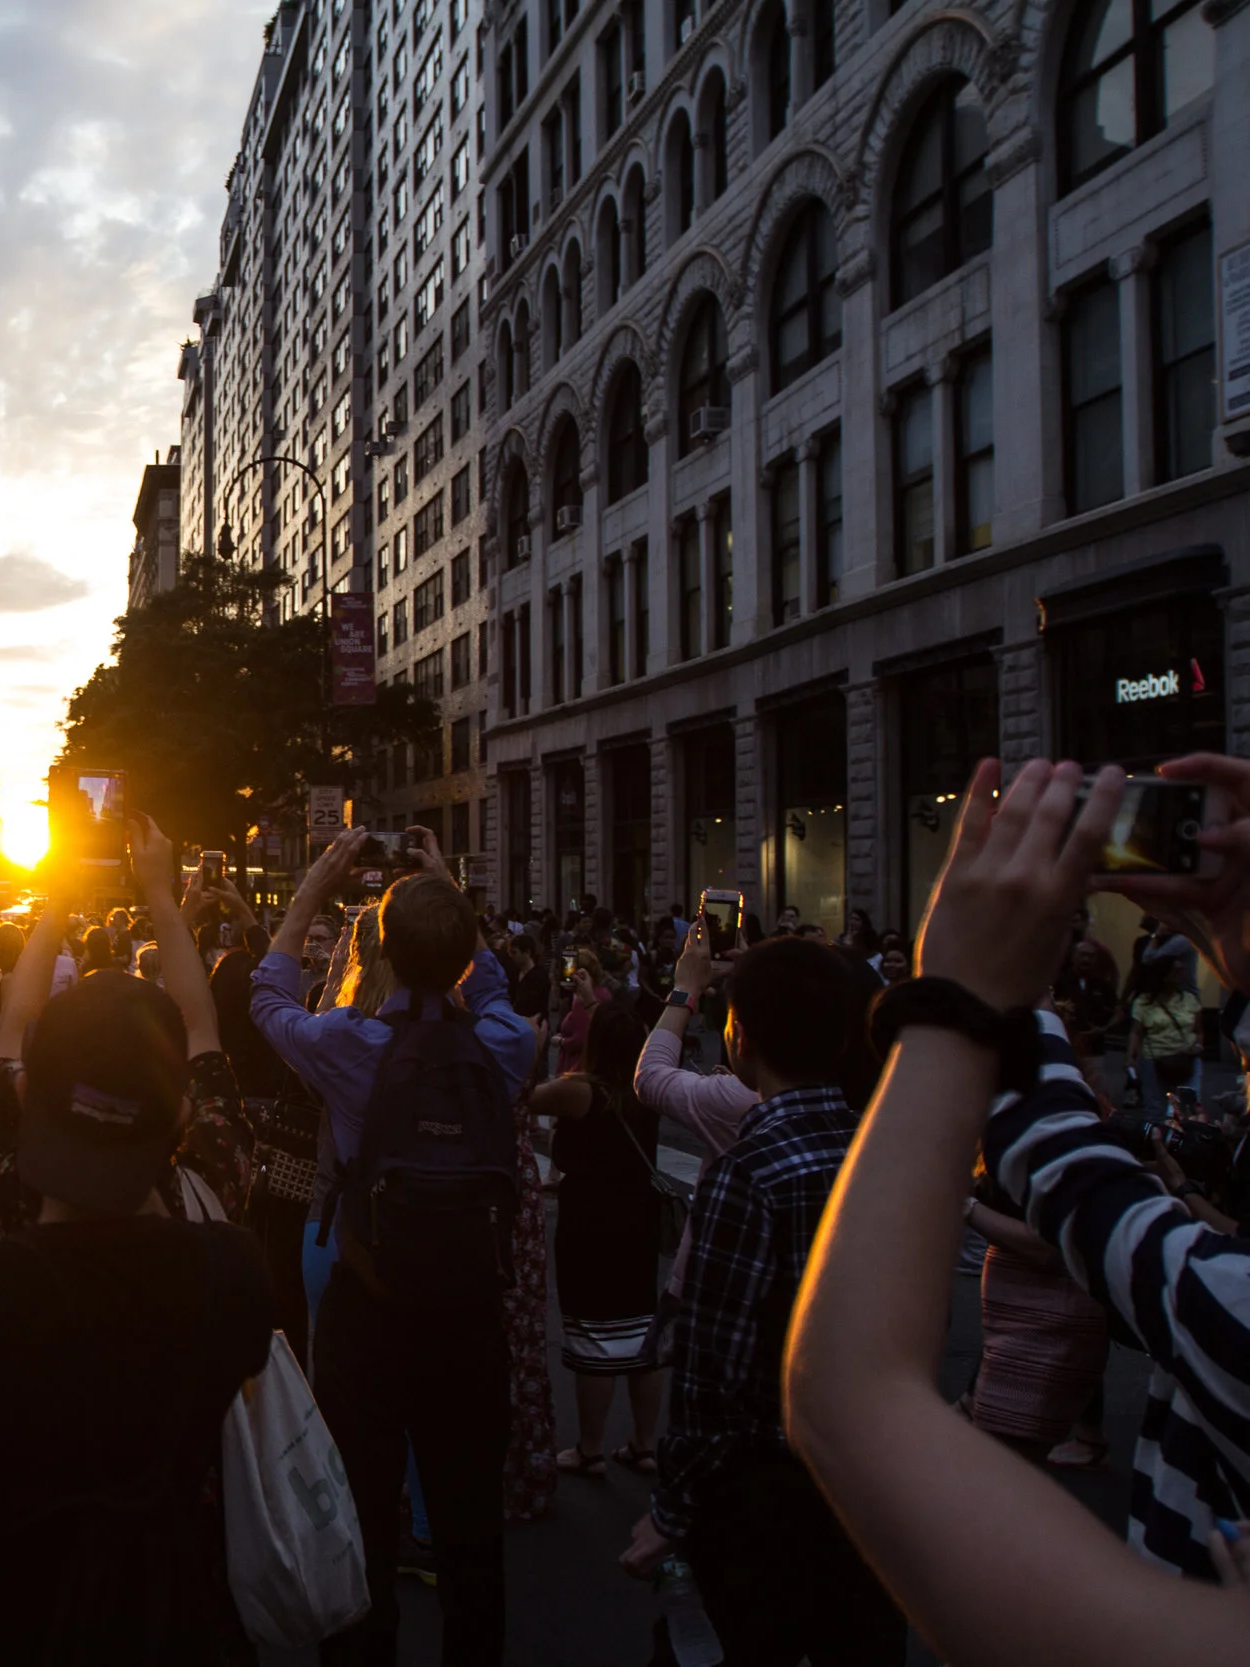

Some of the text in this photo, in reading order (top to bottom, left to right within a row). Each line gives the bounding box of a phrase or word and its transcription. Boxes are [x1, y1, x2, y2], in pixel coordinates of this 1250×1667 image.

[341, 623, 355, 631] WE
[334, 638, 361, 646] UNION
[340, 646, 373, 654] SQUARE
[1115, 669, 1180, 704] Reebok
[314, 810, 340, 826] 25
